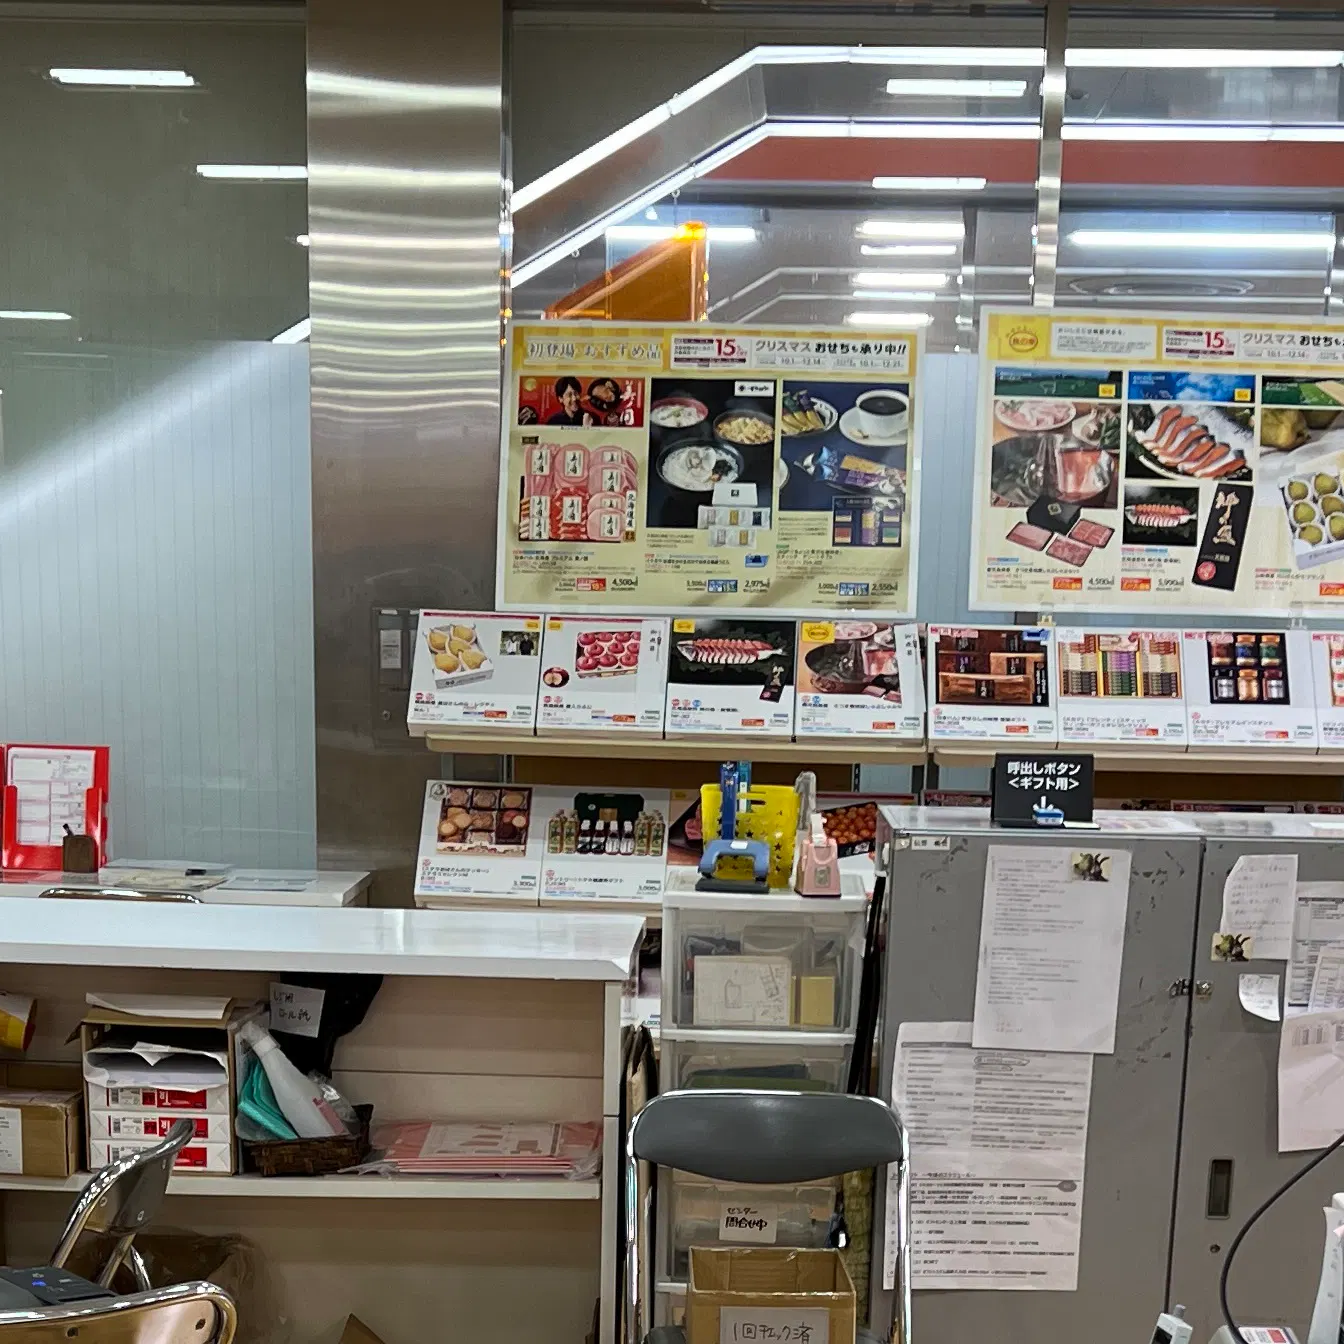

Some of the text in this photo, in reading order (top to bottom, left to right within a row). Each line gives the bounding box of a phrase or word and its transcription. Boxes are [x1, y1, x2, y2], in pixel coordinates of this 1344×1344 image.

[1204, 330, 1224, 348] 15
[1243, 334, 1296, 345] クリスマス
[715, 338, 735, 356] 15
[756, 340, 811, 352] クリスマス
[1007, 761, 1081, 776] 呼出しボタン
[727, 1207, 758, 1215] センター
